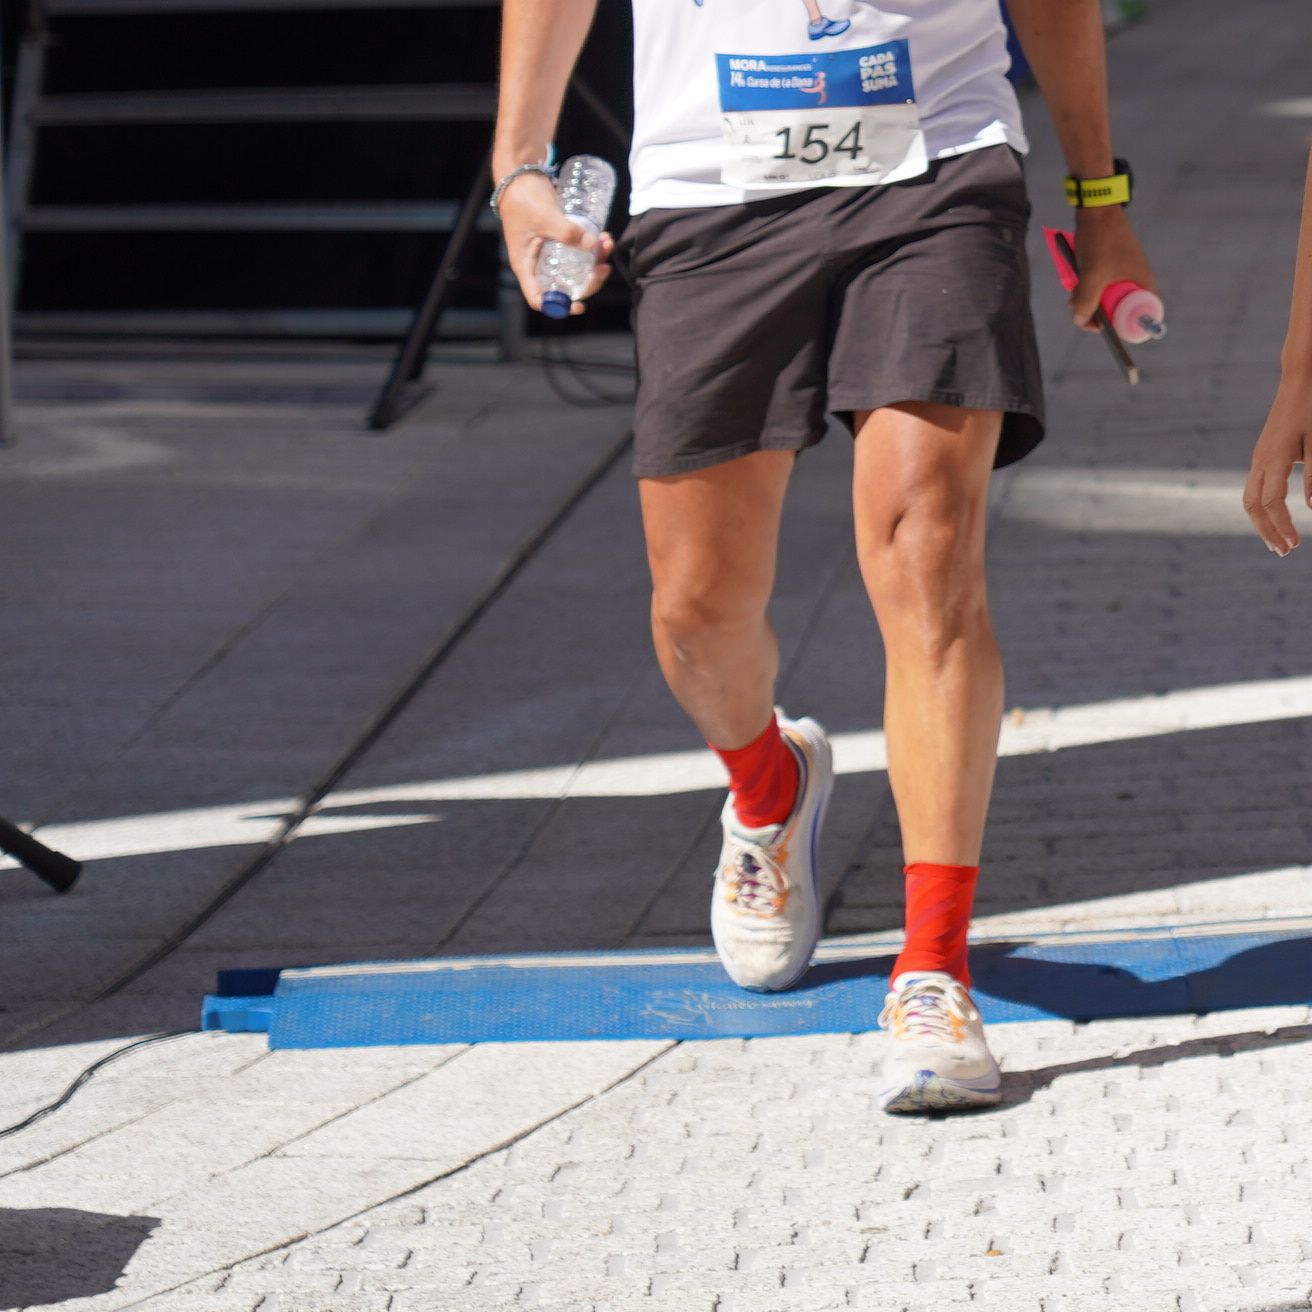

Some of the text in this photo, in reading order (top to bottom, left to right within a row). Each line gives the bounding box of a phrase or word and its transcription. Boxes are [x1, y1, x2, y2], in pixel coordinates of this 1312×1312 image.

[729, 58, 767, 73] MORA
[858, 51, 896, 67] CADA
[859, 62, 897, 81] PAS
[861, 76, 899, 93] SUMA
[773, 121, 864, 164] 154
